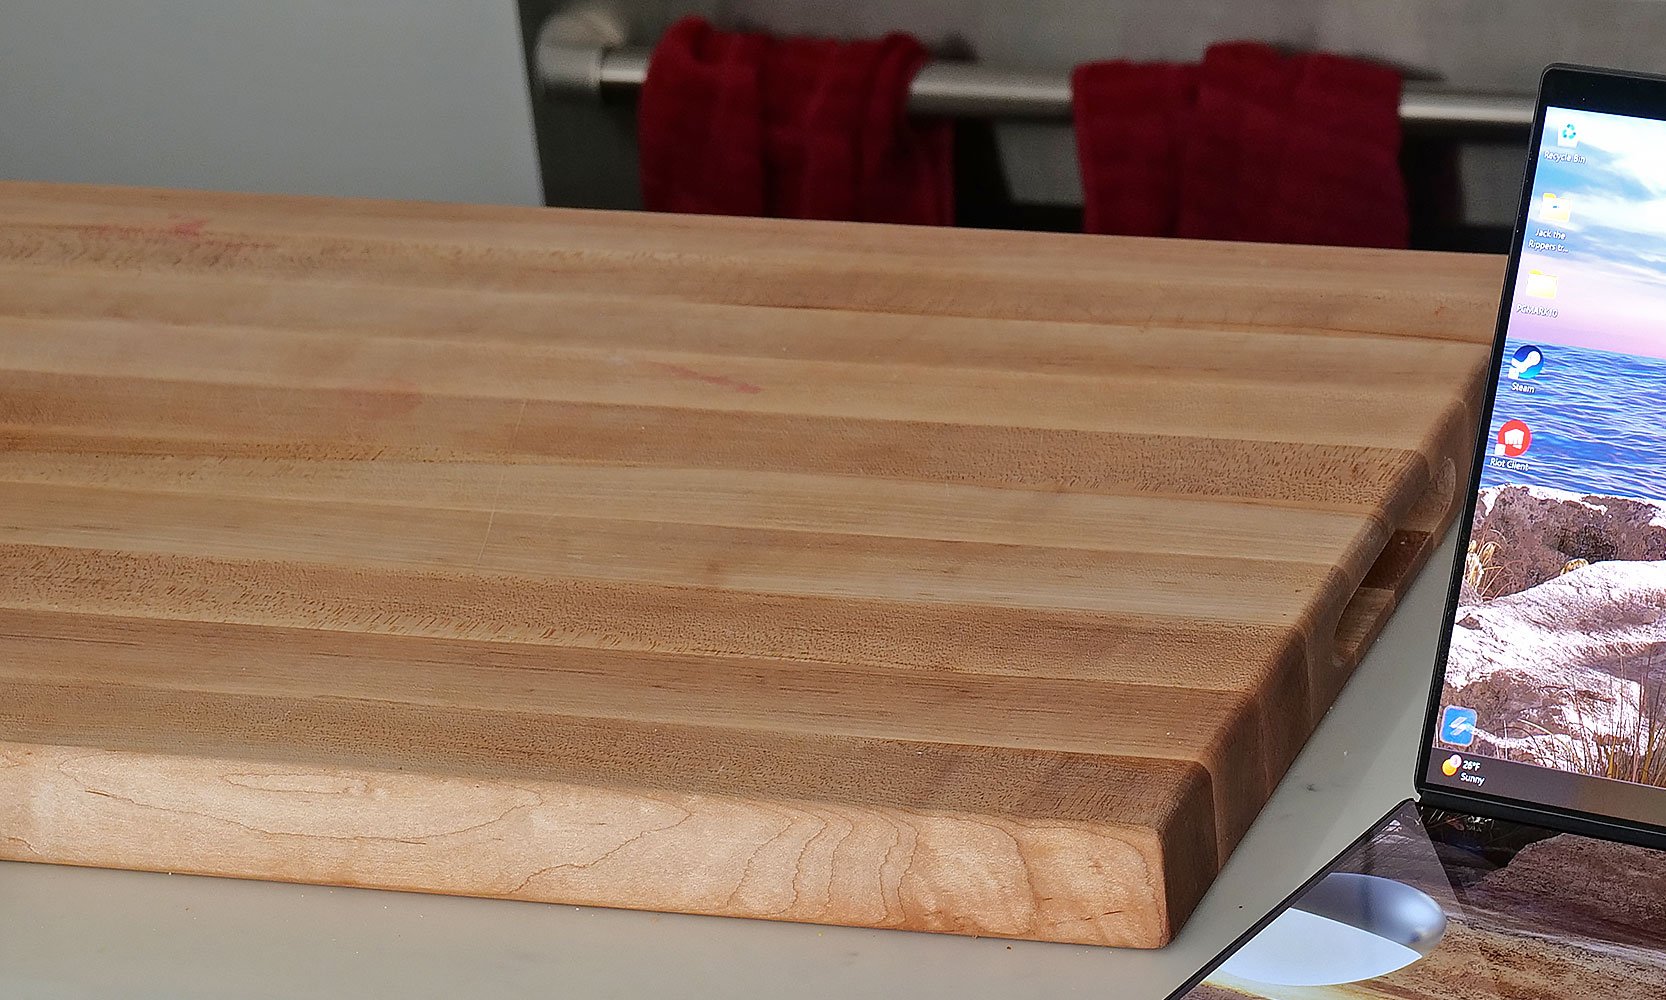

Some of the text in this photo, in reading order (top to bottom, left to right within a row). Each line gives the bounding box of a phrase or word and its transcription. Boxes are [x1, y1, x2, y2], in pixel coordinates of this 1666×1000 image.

[1543, 151, 1586, 164] Recycle Bin
[1535, 228, 1566, 240] Jack the
[1528, 239, 1557, 253] Rippers
[1511, 381, 1536, 393] Steam
[1489, 457, 1530, 471] Riot Client
[1462, 759, 1481, 771] 26°F
[1460, 772, 1485, 787] Sunny
